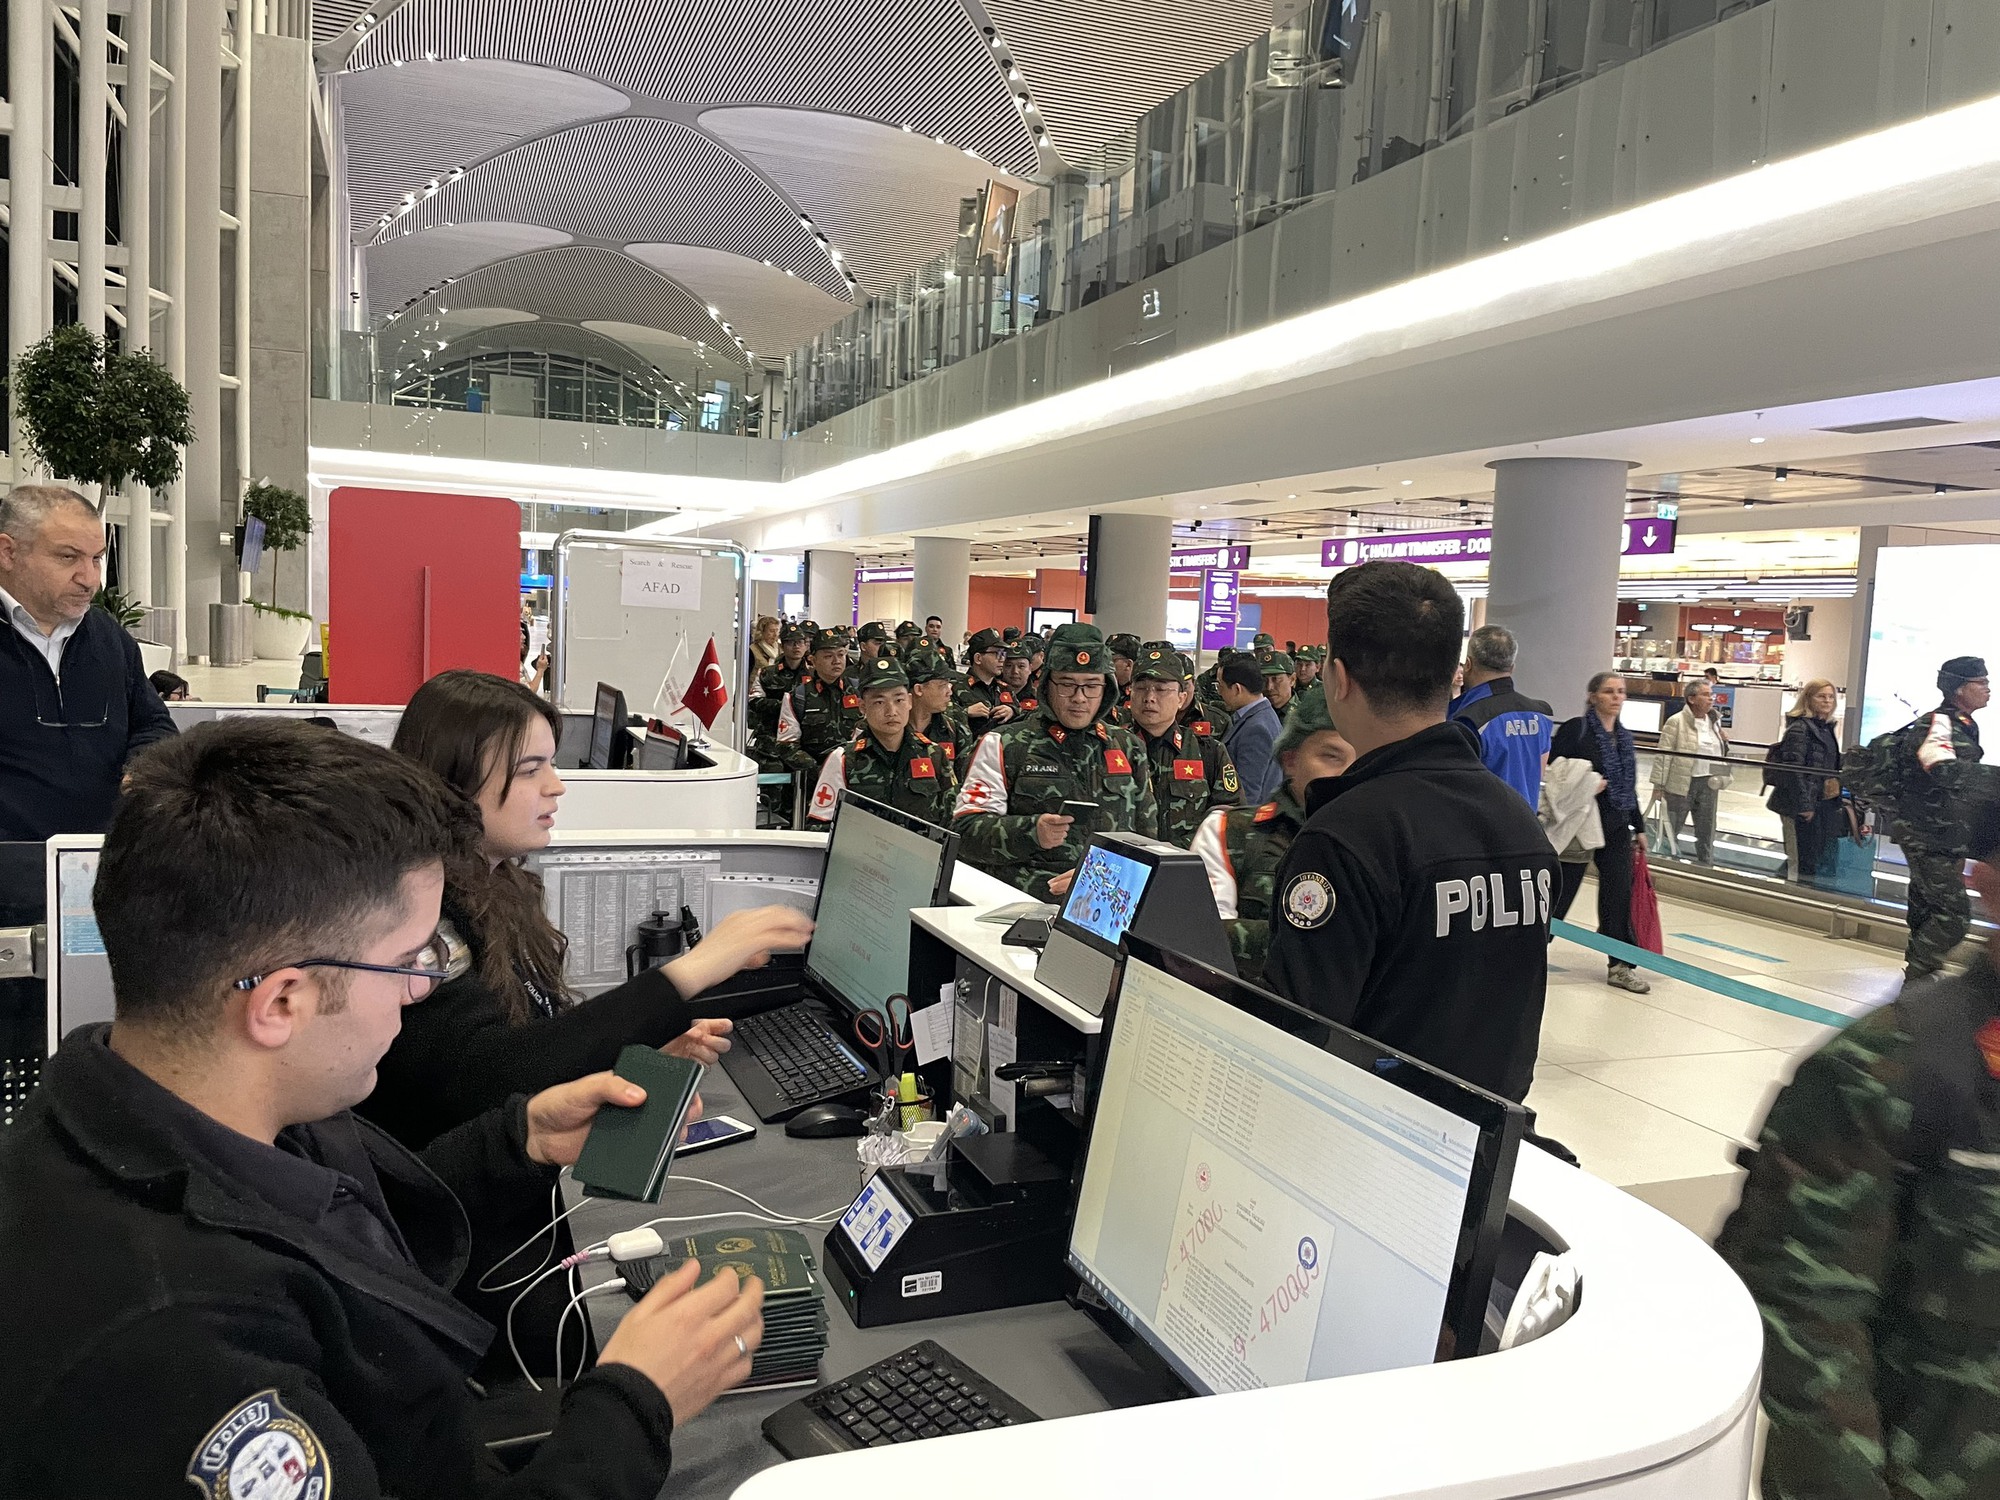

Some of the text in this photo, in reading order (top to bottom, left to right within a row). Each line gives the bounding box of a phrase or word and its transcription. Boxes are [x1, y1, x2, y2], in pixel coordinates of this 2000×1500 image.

[1408, 540, 1460, 556] TRANSFER
[671, 561, 693, 569] Rescue
[641, 582, 681, 594] AFAD
[1505, 719, 1539, 737] AFAD
[523, 980, 543, 1005] POLICE
